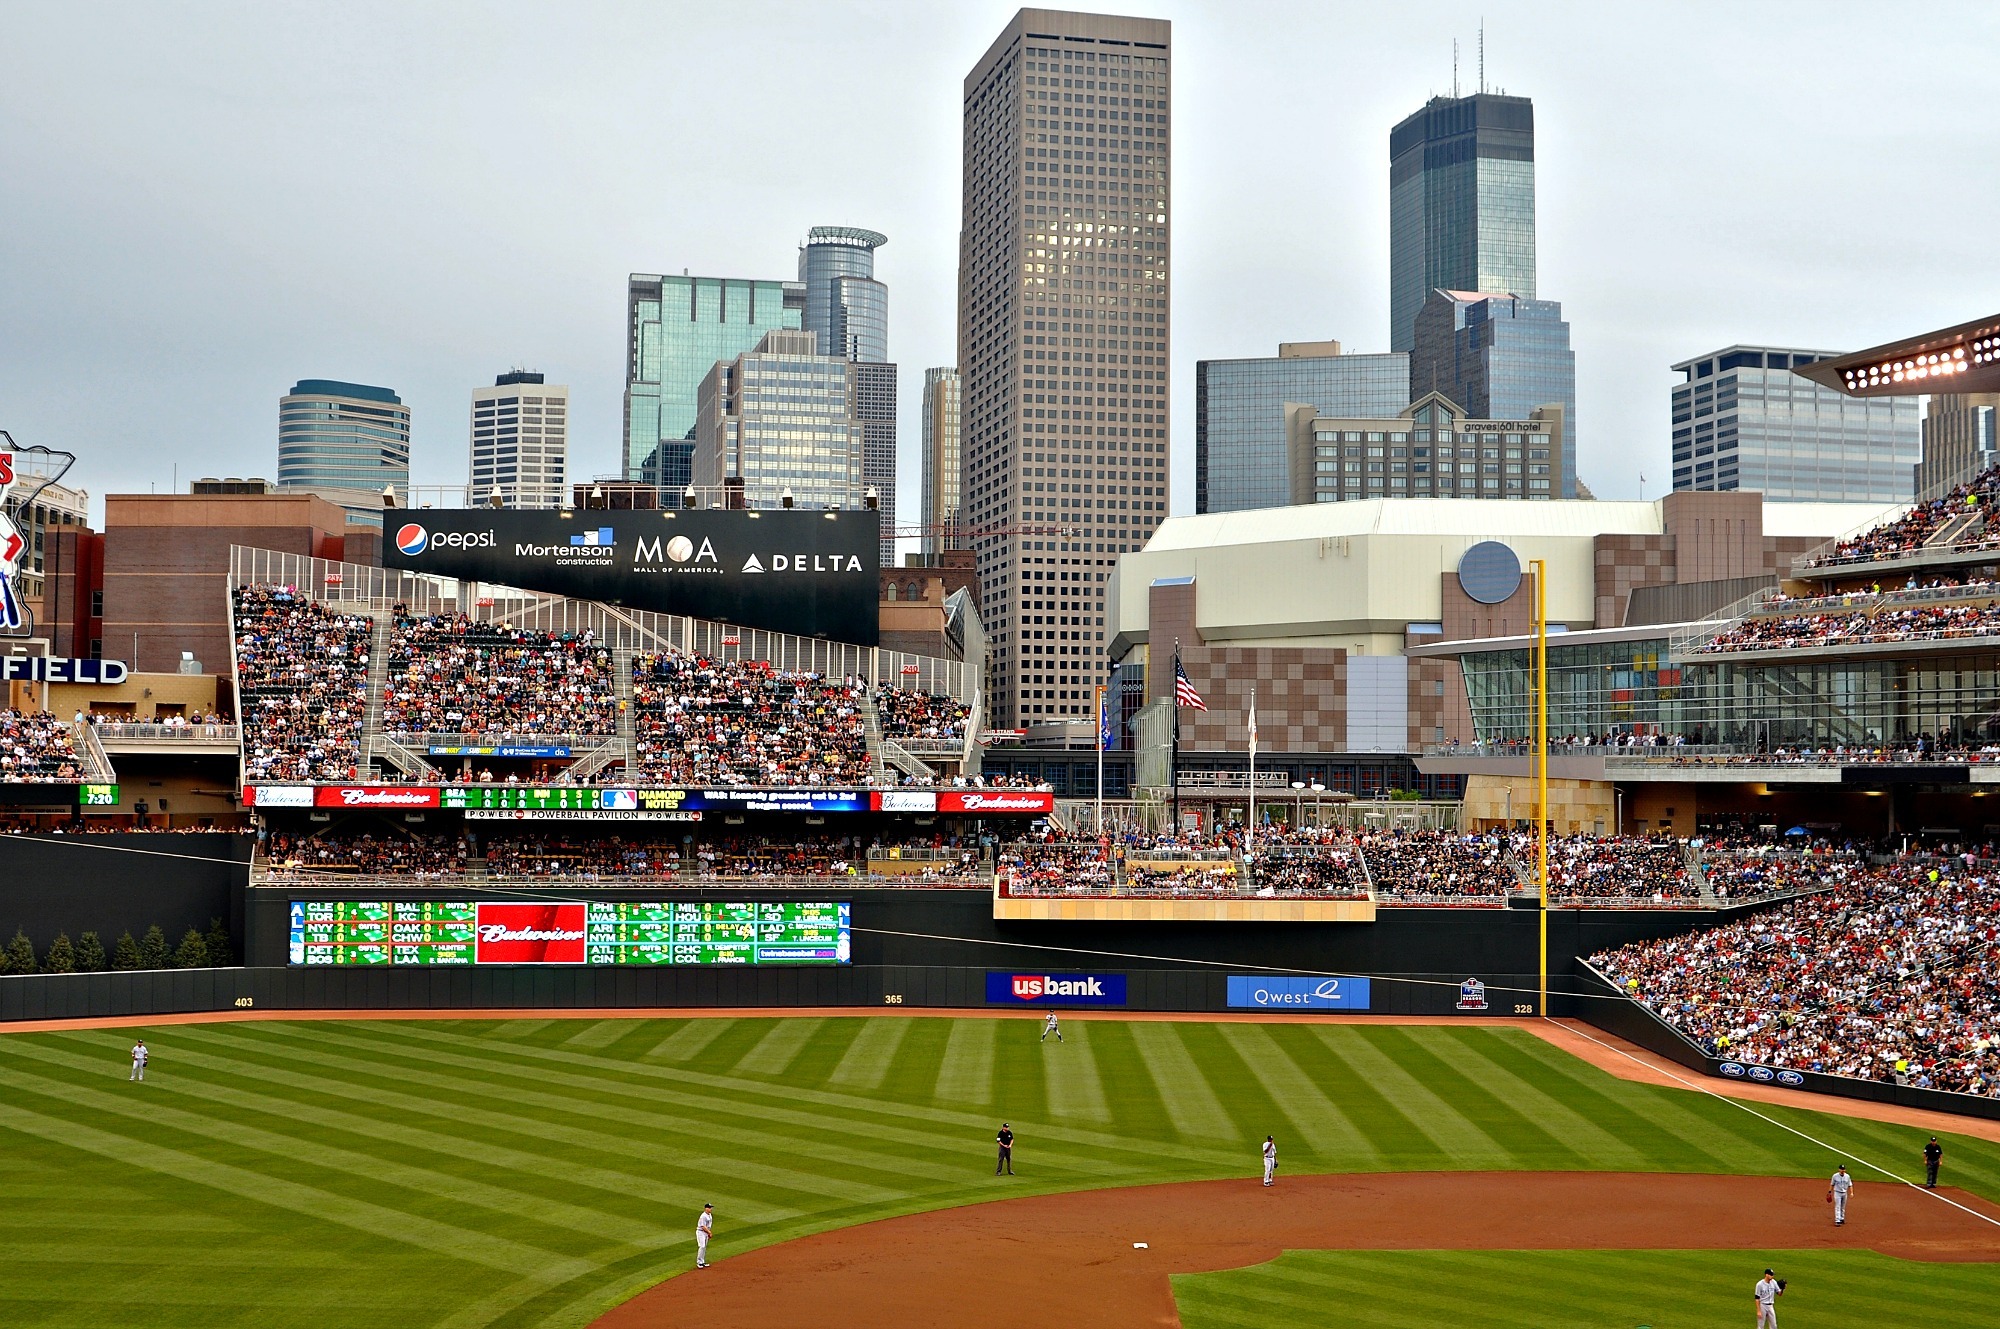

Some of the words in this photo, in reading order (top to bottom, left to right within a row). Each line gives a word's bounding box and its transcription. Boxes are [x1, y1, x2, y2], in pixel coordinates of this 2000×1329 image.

[1464, 424, 1497, 432] graves
[1517, 422, 1541, 431] hotel
[515, 543, 613, 557] Mortenson
[556, 558, 613, 566] construction
[772, 554, 863, 572] DELTA
[328, 574, 342, 582] 237
[725, 636, 740, 644] 239
[3, 656, 128, 684] FIELD
[904, 665, 918, 673] 240
[86, 785, 112, 794] TIME
[446, 789, 467, 797] SEA
[484, 789, 491, 797] 0
[501, 789, 507, 798] 1
[519, 789, 526, 798] 0
[576, 789, 583, 799] S
[86, 794, 113, 805] 7:20
[340, 789, 431, 805] Budweiser
[638, 790, 686, 800] DIAMOND
[447, 799, 466, 808] MIN
[484, 799, 491, 808] 0
[501, 799, 508, 808] 0
[539, 799, 545, 809] 1
[560, 799, 568, 809] 0
[576, 799, 582, 809] 1
[592, 799, 600, 809] 0
[645, 799, 678, 809] NOTES
[960, 794, 1045, 810] Budweiser
[531, 811, 589, 819] POWERBALL
[592, 811, 639, 819] PAVILION
[307, 902, 334, 912] CLE
[337, 902, 345, 911] 0
[381, 902, 388, 911] 3
[394, 902, 420, 912] BAL
[423, 902, 432, 912] 0
[468, 902, 475, 911] 2
[593, 903, 613, 912] PHI
[678, 903, 700, 912] MIL
[704, 902, 712, 912] 0
[747, 903, 754, 912] 2
[761, 903, 785, 913] FLA
[307, 912, 334, 921] TOR
[337, 912, 344, 921] 7
[398, 912, 417, 921] KC
[423, 912, 432, 921] 0
[589, 912, 618, 922] WAS
[619, 912, 627, 922] 3
[675, 913, 702, 922] HOU
[764, 912, 782, 922] SD
[307, 923, 334, 933] NYY
[337, 923, 345, 933] 2
[381, 923, 388, 932] 1
[393, 923, 421, 933] OAK
[423, 923, 432, 933] 0
[467, 923, 475, 932] 3
[592, 924, 613, 933] ARI
[619, 923, 627, 933] 4
[662, 923, 669, 932] 2
[679, 923, 699, 933] PIT
[704, 923, 712, 933] 0
[760, 924, 786, 933] LAD
[310, 933, 329, 943] TB
[337, 933, 345, 942] 0
[392, 934, 424, 943] CHW
[424, 933, 432, 942] 0
[478, 925, 584, 943] Budweiser
[589, 934, 617, 942] NYM
[619, 933, 627, 942] 5
[677, 933, 700, 942] STL
[704, 933, 712, 942] 0
[764, 933, 781, 942] SF
[307, 945, 334, 955] DET
[337, 945, 345, 955] 2
[381, 945, 388, 954] 2
[394, 945, 420, 955] TEX
[591, 945, 615, 954] ATL
[619, 945, 626, 954] 1
[662, 945, 668, 953] 3
[674, 945, 702, 954] CHC
[306, 955, 334, 965] BOS
[337, 954, 345, 964] 0
[394, 955, 420, 964] LAA
[592, 954, 615, 964] CIN
[619, 954, 627, 964] 3
[675, 954, 701, 964] COL
[885, 994, 903, 1004] 365
[1254, 989, 1310, 1005] Qwest
[234, 998, 253, 1007] 403
[1514, 1004, 1533, 1014] 328
[1724, 1064, 1741, 1075] Ford
[1752, 1068, 1769, 1079] Ford
[1781, 1072, 1799, 1084] Ford
